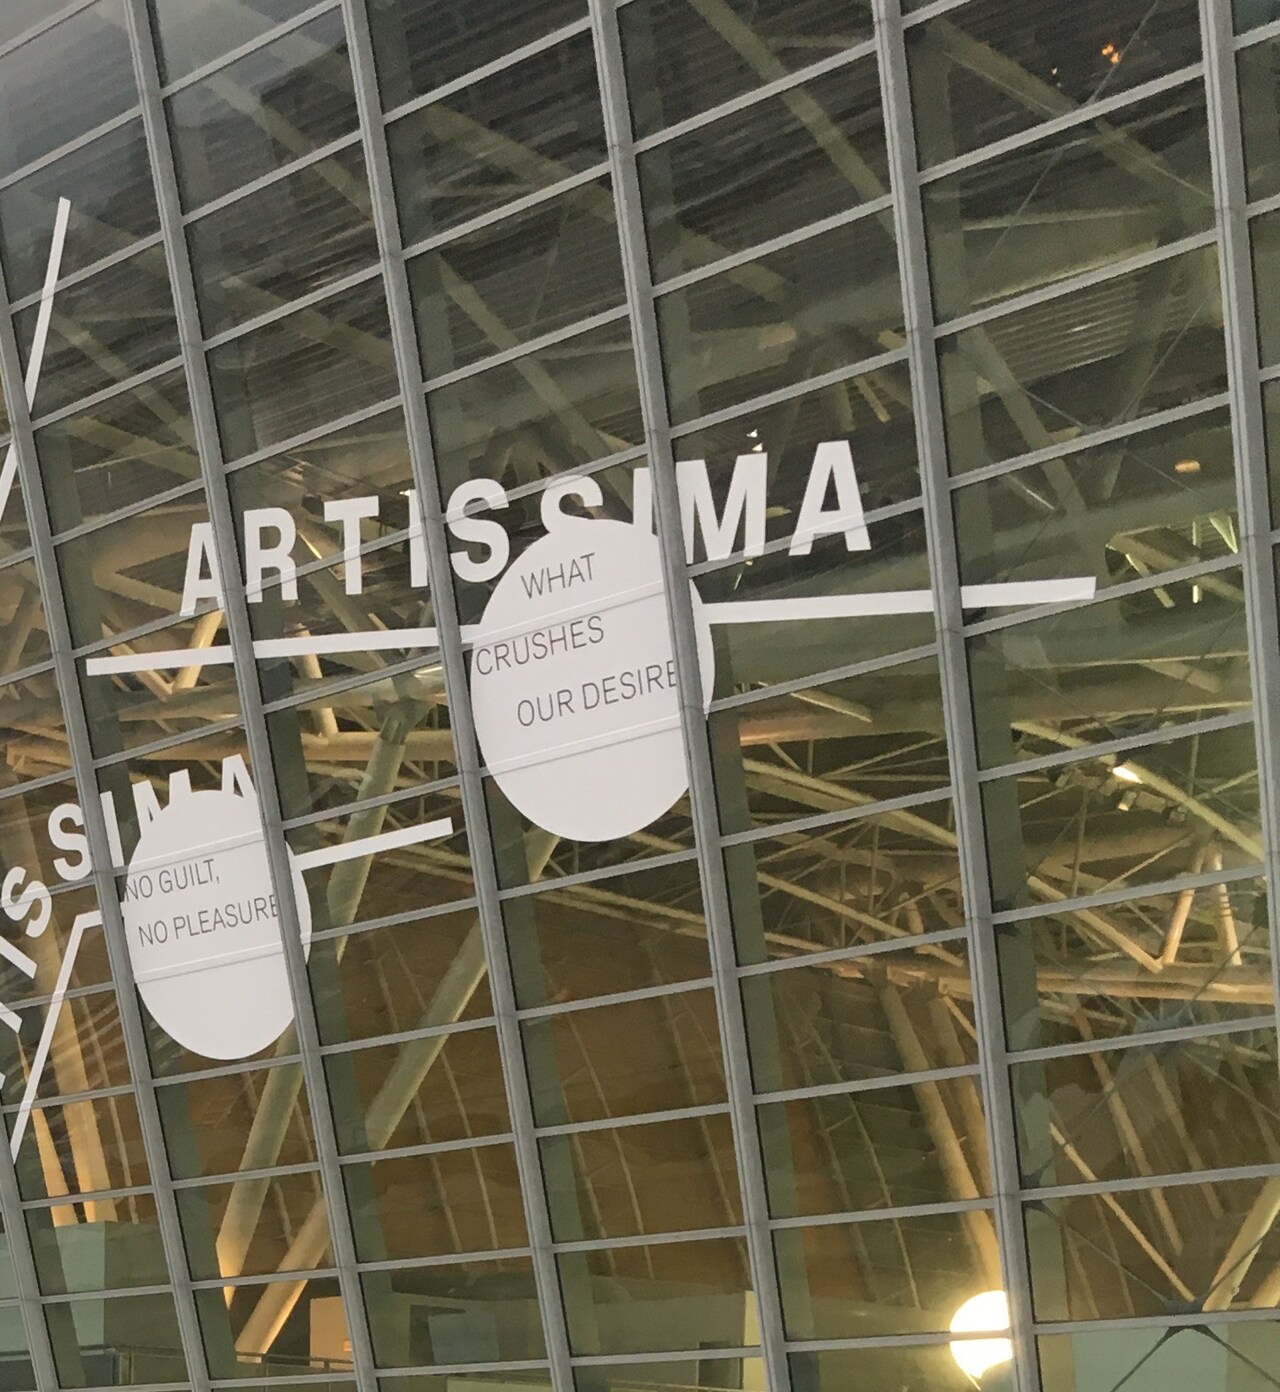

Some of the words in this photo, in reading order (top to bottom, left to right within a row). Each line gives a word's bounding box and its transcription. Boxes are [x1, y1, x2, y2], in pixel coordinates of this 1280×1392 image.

[521, 552, 595, 599] WHAT
[476, 615, 605, 676] CRUSHES
[517, 689, 575, 727] OUR
[582, 660, 677, 710] DESIRE
[124, 874, 153, 903] NO
[158, 858, 221, 894] GUILT,
[138, 920, 168, 948] NO
[173, 894, 279, 940] PLEASURE
